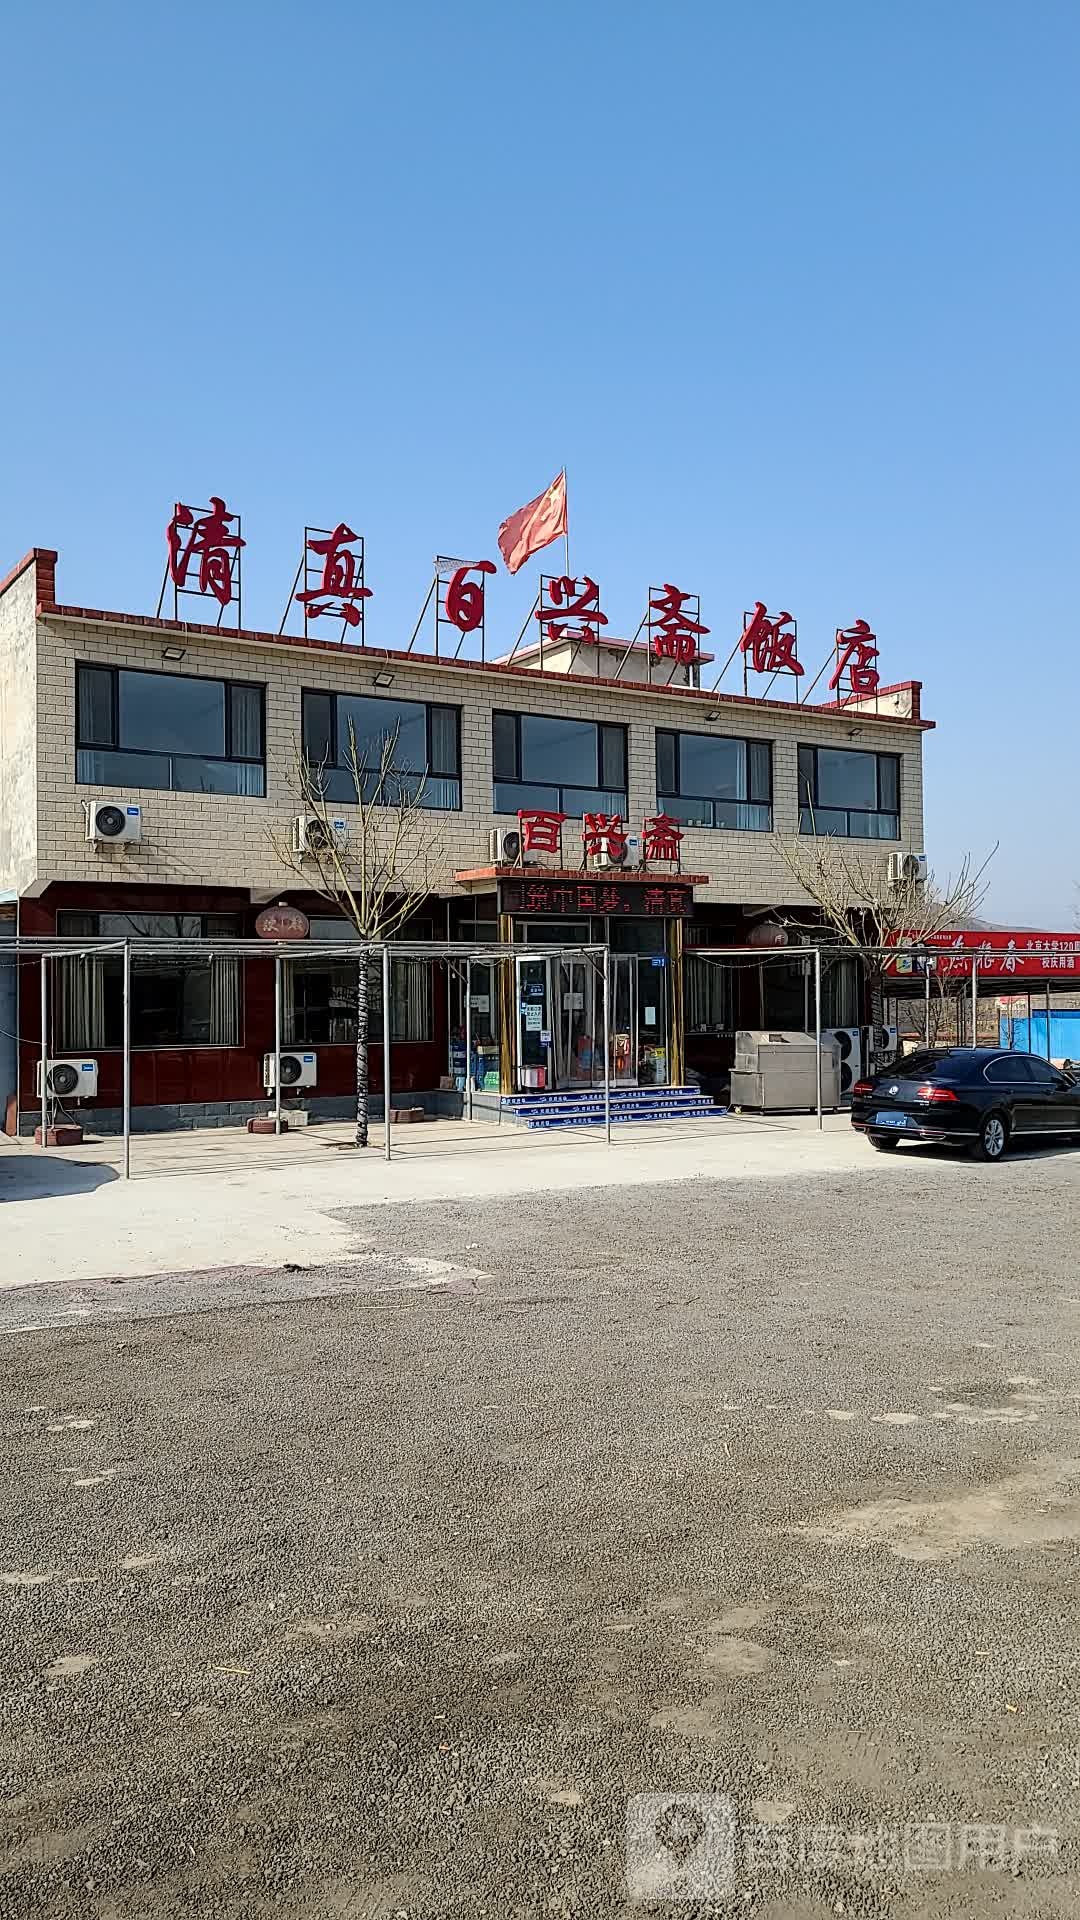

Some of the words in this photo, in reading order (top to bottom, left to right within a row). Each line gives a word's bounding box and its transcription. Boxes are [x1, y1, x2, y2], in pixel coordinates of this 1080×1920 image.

[167, 496, 880, 695] 清真百兴斋饭店
[517, 809, 684, 861] 百兴斋
